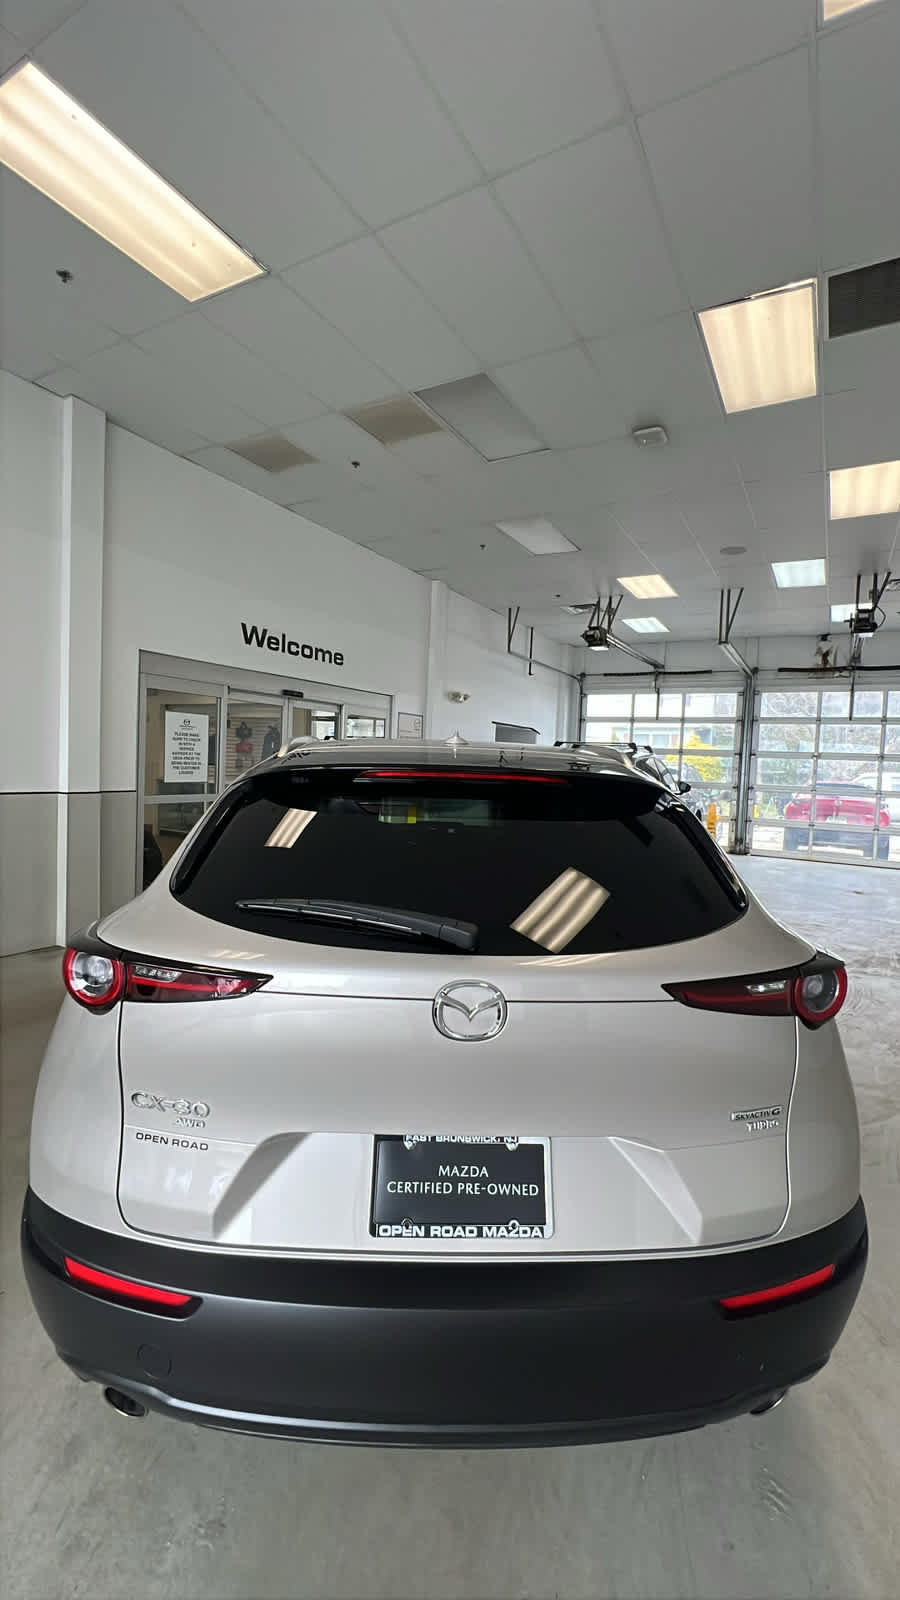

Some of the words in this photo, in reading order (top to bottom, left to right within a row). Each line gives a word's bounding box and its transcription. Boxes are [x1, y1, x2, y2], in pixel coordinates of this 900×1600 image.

[241, 622, 344, 665] Welcome
[131, 1091, 210, 1118] CX-30
[176, 1117, 206, 1128] AWD
[136, 1132, 169, 1145] OPEN
[172, 1138, 209, 1151] ROAD
[438, 1165, 489, 1178] MAZDA
[386, 1181, 453, 1194] CERTIFIED
[457, 1182, 539, 1196] PRE-OWNED
[378, 1224, 425, 1237] OPEN
[430, 1225, 478, 1238] ROAD
